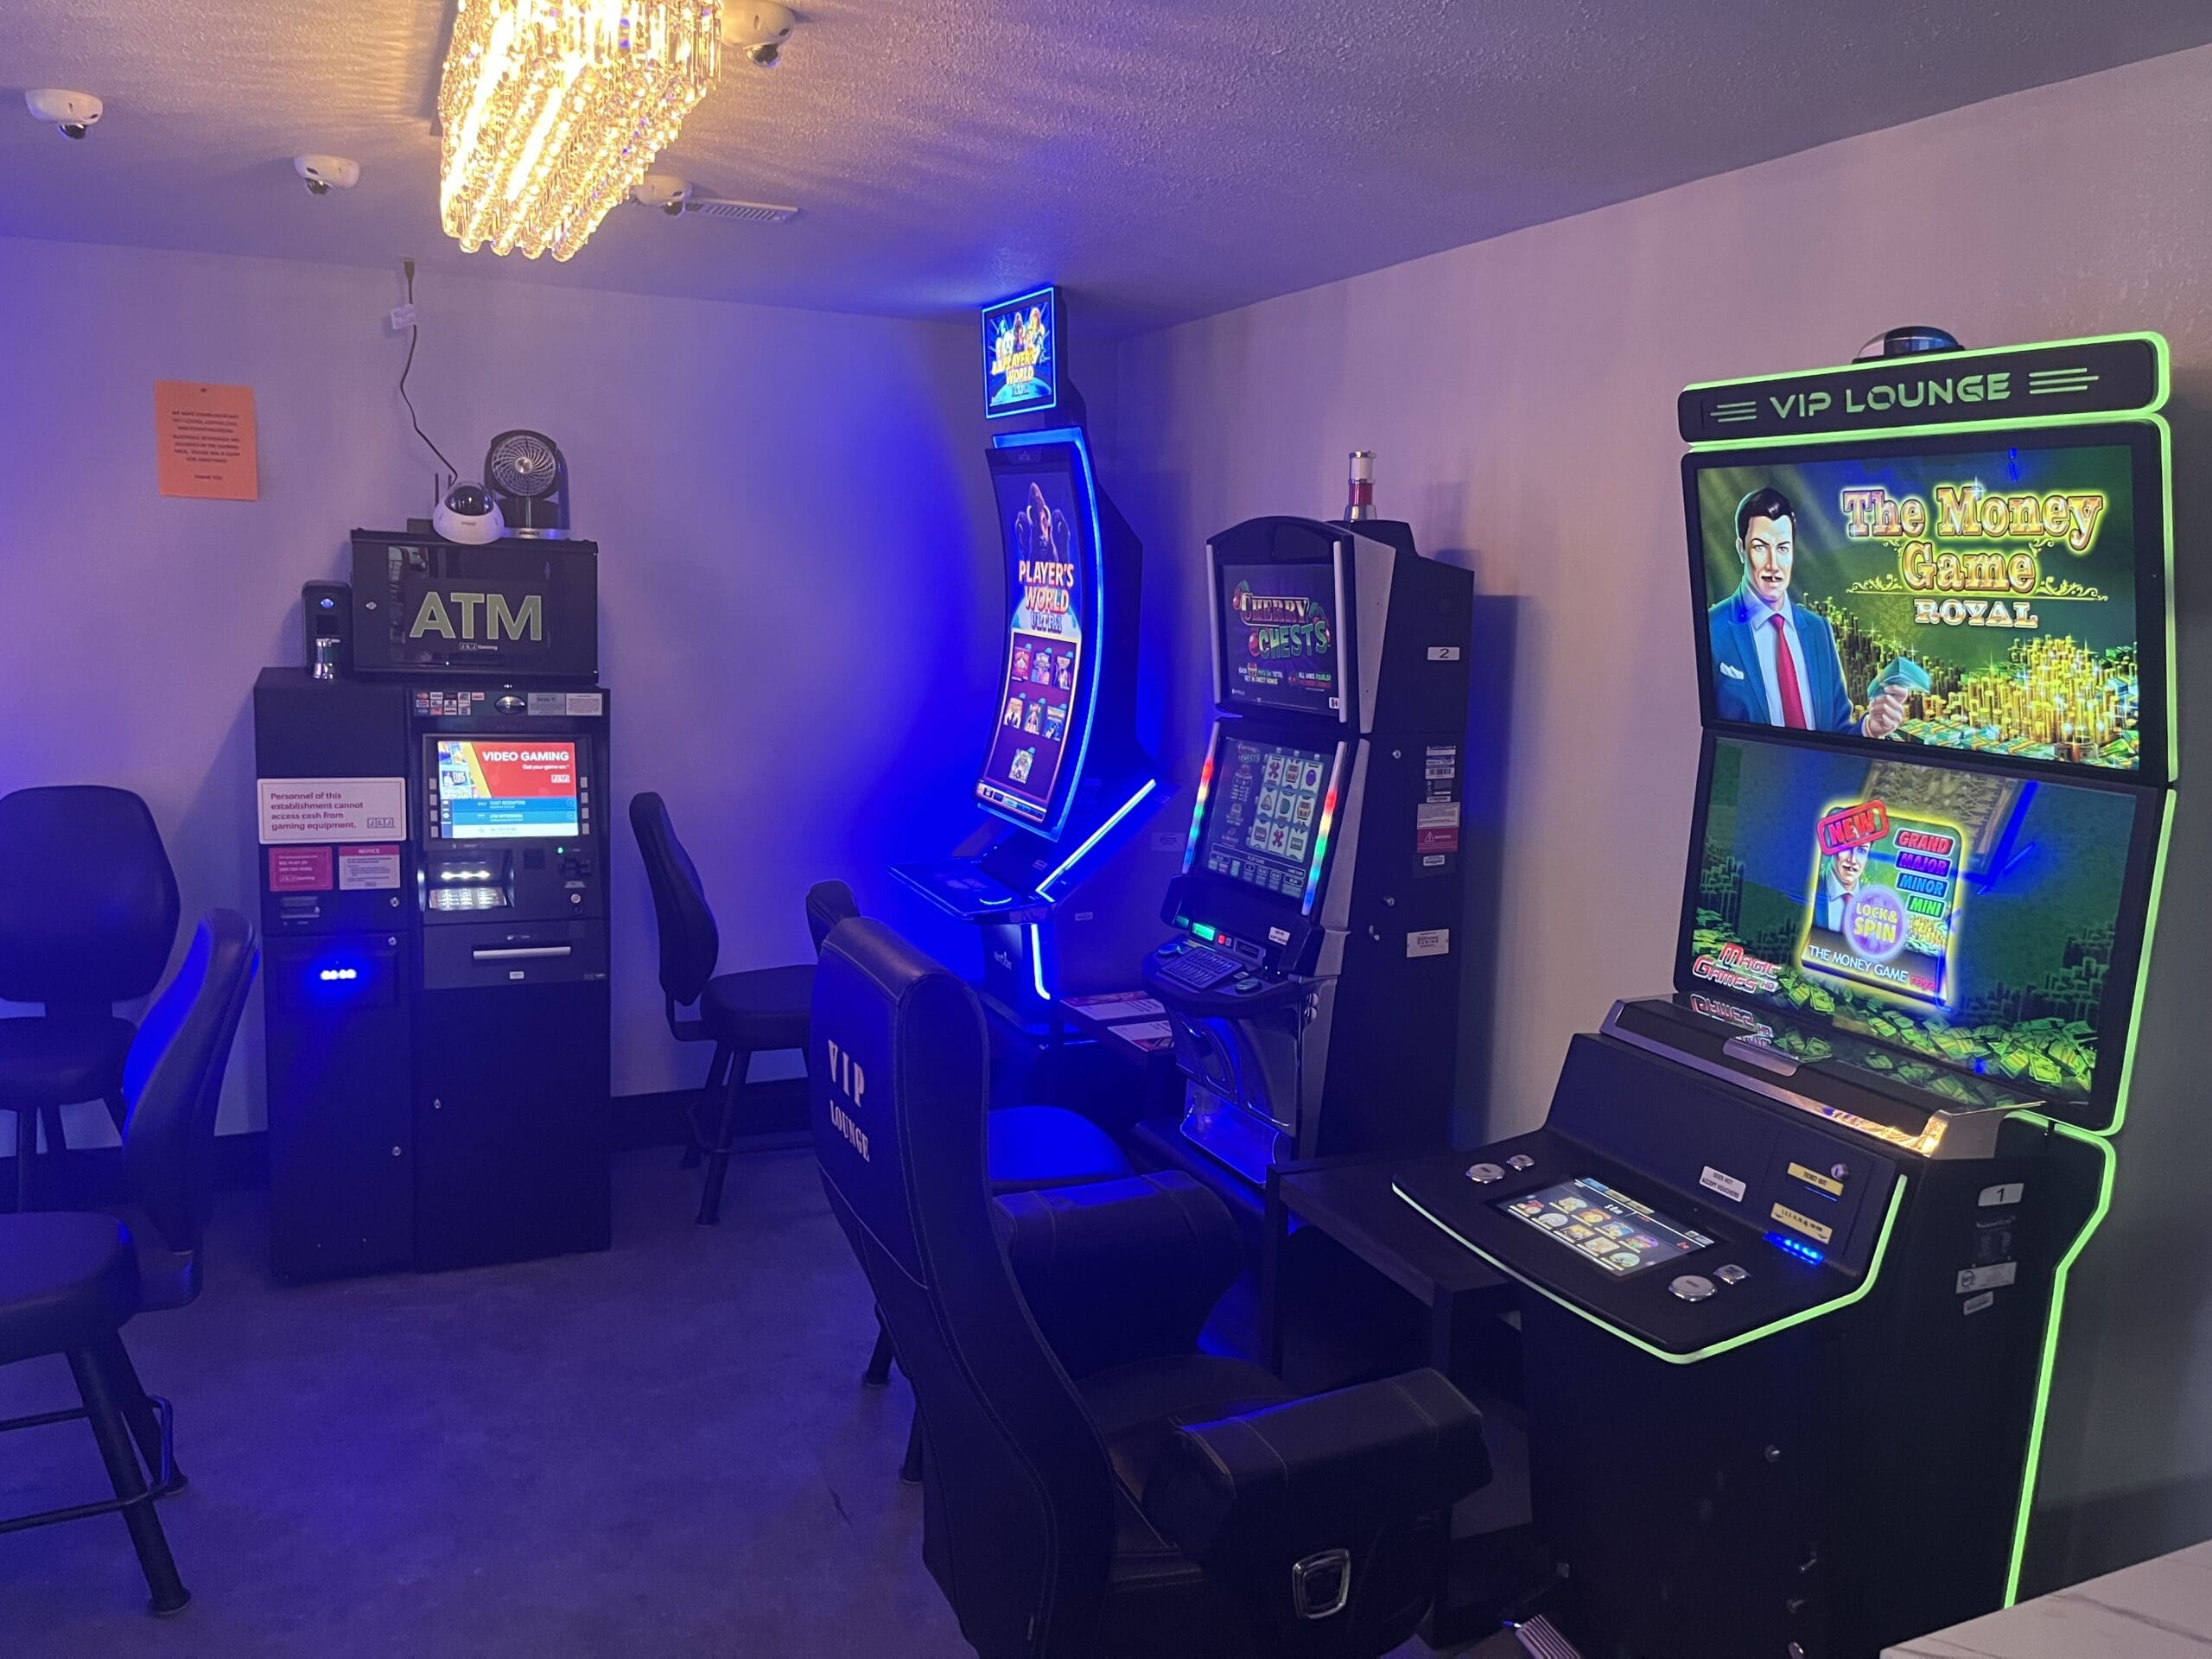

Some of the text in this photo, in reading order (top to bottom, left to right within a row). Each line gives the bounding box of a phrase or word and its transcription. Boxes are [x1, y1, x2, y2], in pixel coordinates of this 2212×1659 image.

[1770, 372, 2012, 419] VIP LOUNGE
[1841, 486, 2104, 551] The Money
[1019, 560, 1075, 588] PLAYER'S
[1902, 540, 2037, 594] Game
[1025, 585, 1071, 614] WORLD
[1240, 593, 1307, 623] CHERRY
[1913, 598, 2039, 629] ROYAL
[409, 591, 542, 641] ATM
[1031, 611, 1063, 633] ULTRA
[1258, 620, 1328, 659] CHESTS
[1440, 648, 1449, 658] 2
[481, 750, 570, 761] VIDEO GAMING
[270, 802, 333, 810] establishment
[302, 811, 321, 820] cash
[271, 821, 357, 831] gaming equipment.
[1827, 809, 1877, 847] NEW
[1897, 831, 1950, 855] GRAND
[1898, 852, 1948, 875] MAJOR
[1899, 874, 1945, 896] MINOR
[1909, 897, 1942, 916] MINI
[1853, 916, 1897, 944] SPIN
[1692, 955, 1758, 994] GAMES
[1717, 942, 1783, 979] MAGIC
[1808, 944, 1937, 991] THE MONEY GAME roya
[828, 1039, 865, 1108] VIP
[830, 1098, 870, 1163] LOUNGE
[1996, 1187, 2005, 1203] 1
